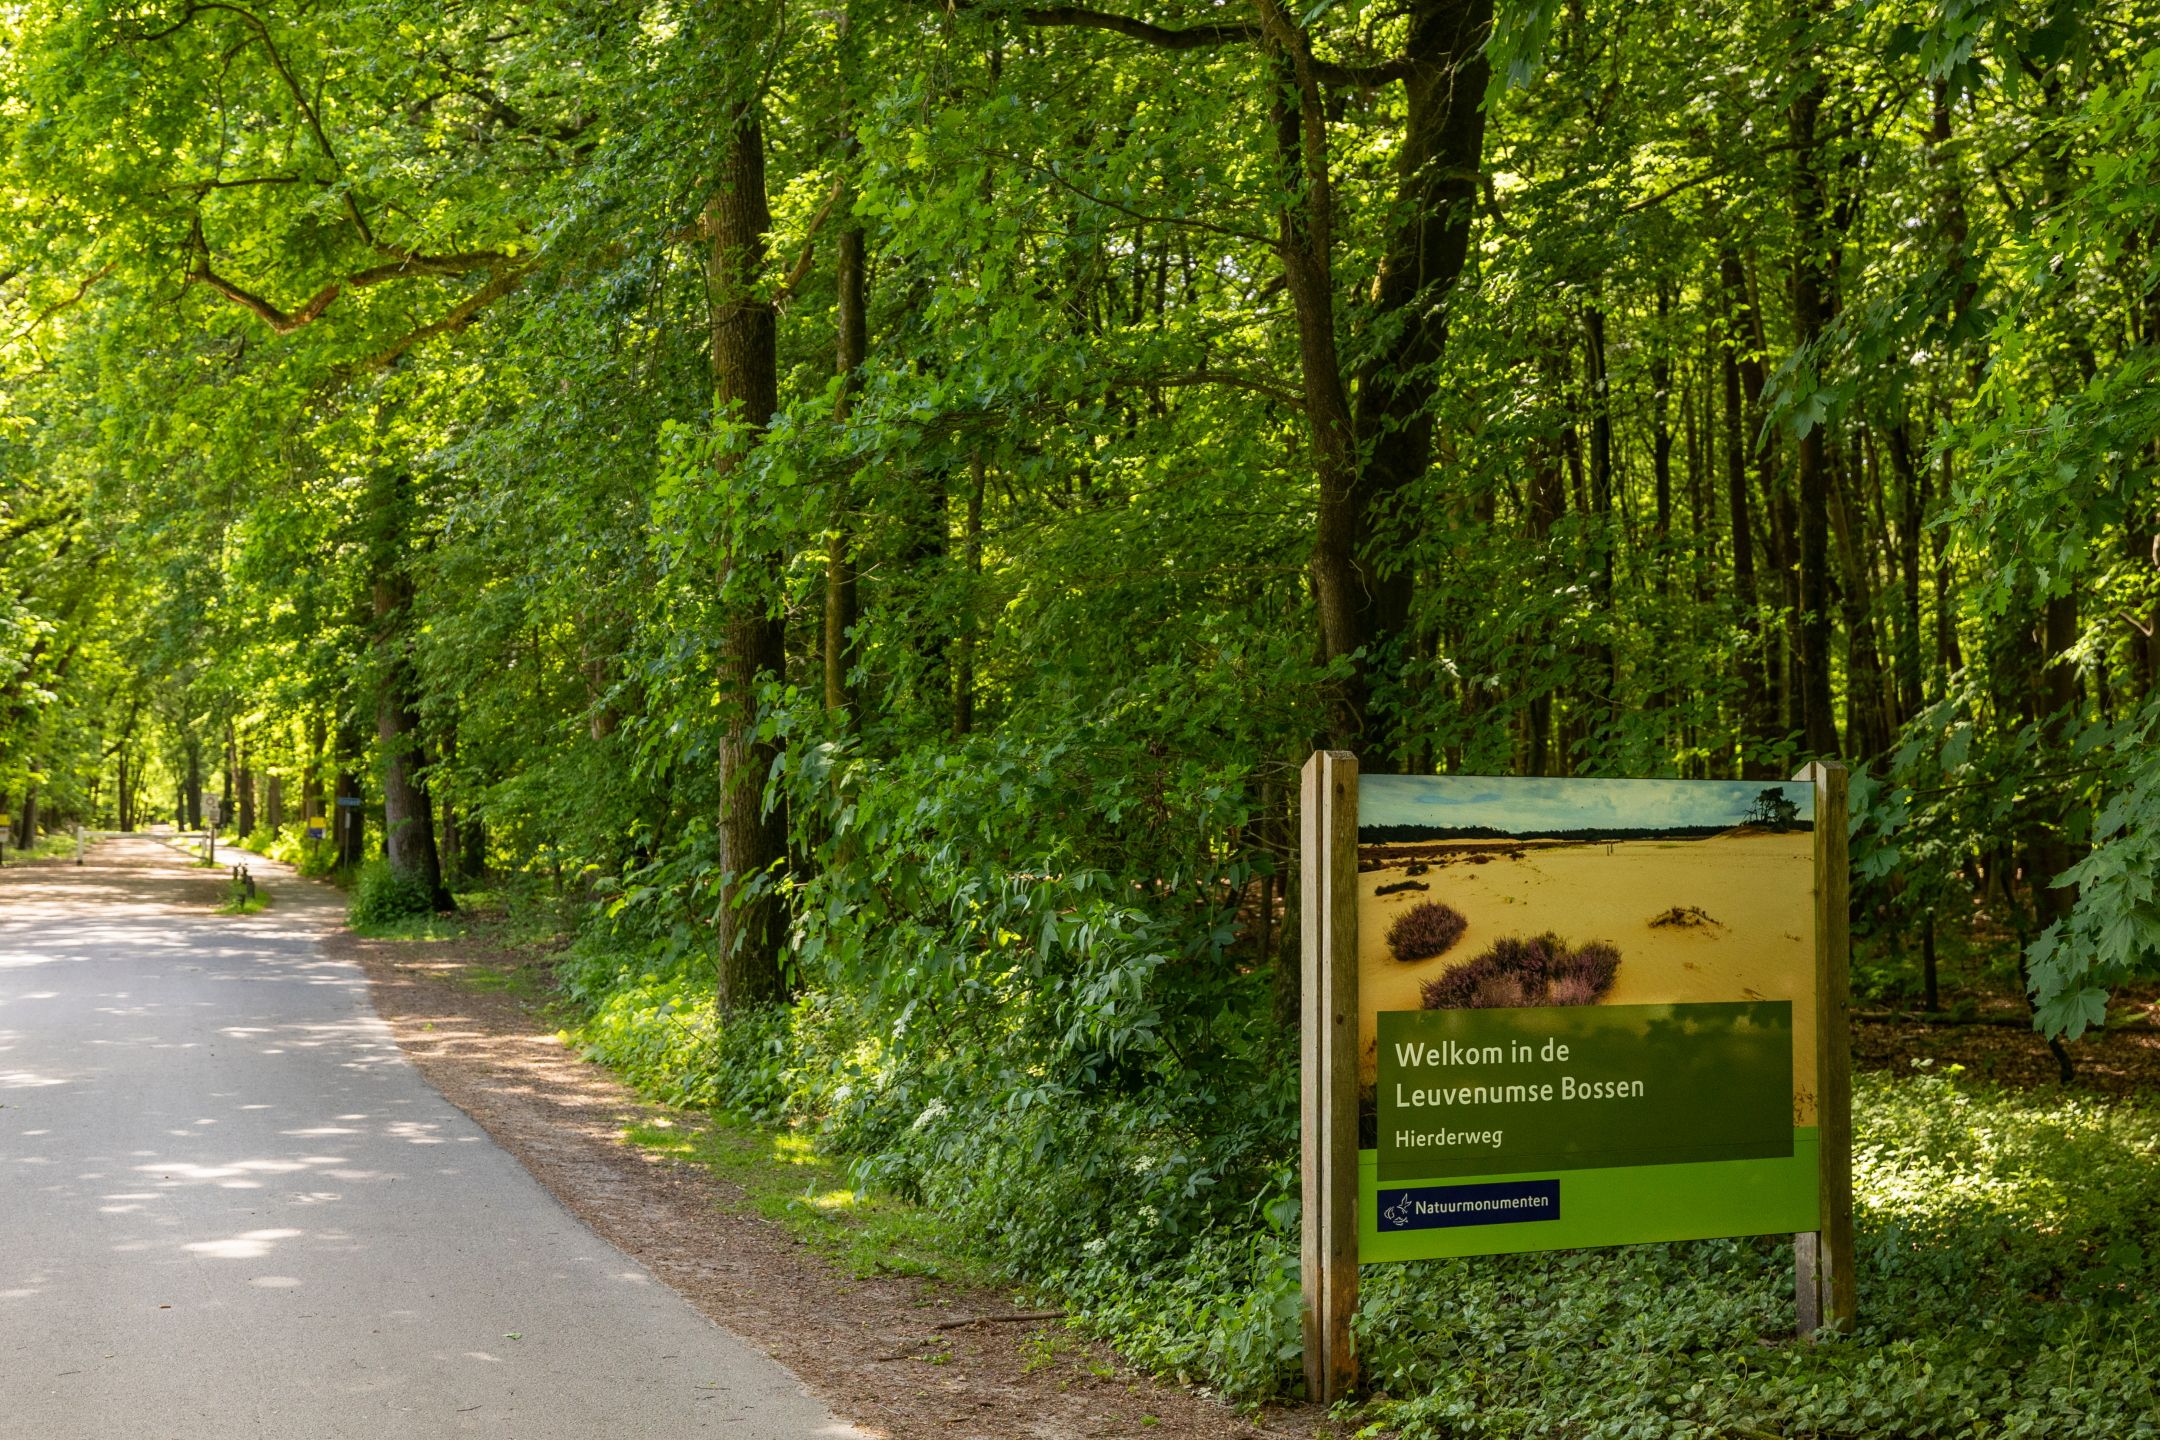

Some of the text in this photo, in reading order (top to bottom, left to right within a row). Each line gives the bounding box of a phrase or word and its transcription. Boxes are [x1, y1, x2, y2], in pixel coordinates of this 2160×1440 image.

[1395, 1036, 1569, 1068] Welkom in de
[1396, 1076, 1644, 1108] Leuvenumse Bossen
[1395, 1127, 1503, 1149] Hierderweg
[1415, 1195, 1549, 1215] Natuurmonumenten
